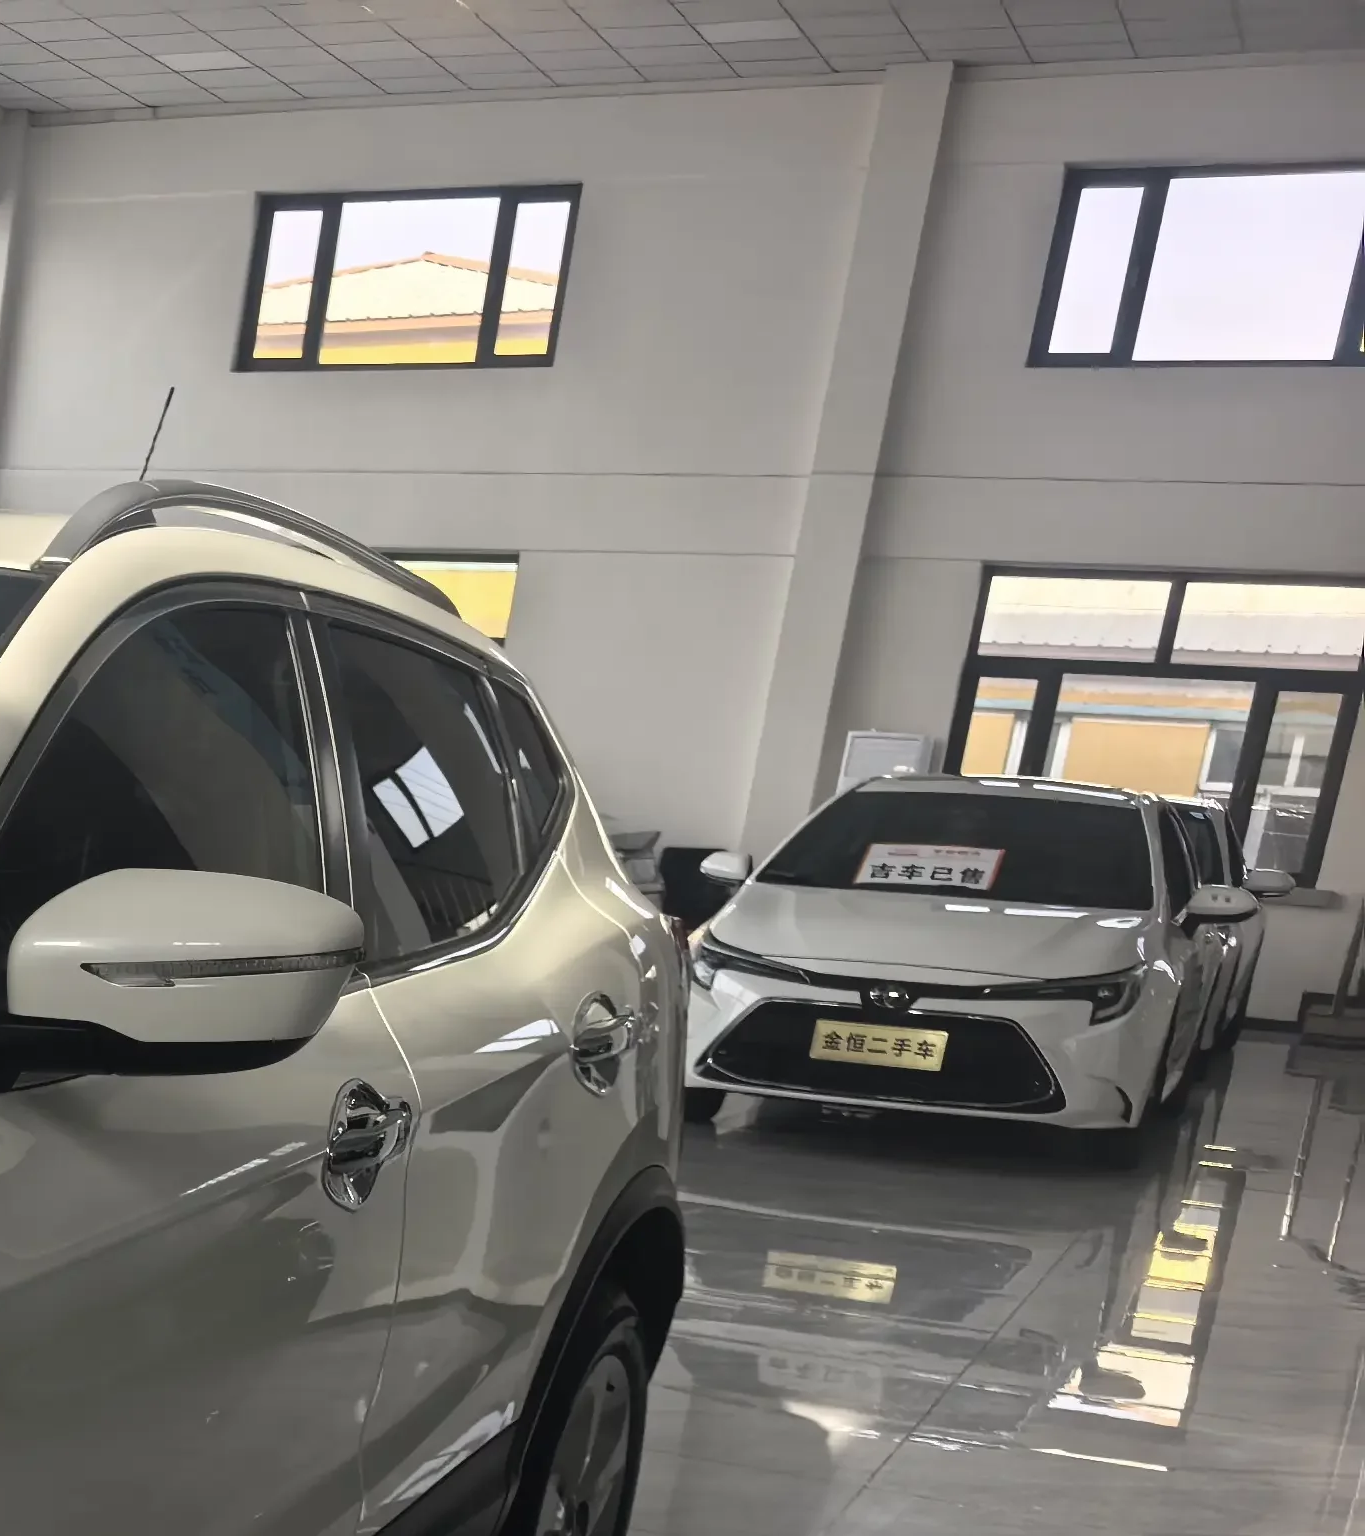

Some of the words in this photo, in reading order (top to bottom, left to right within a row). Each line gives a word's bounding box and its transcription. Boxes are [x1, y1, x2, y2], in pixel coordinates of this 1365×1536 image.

[821, 1030, 937, 1060] 金恒二手车
